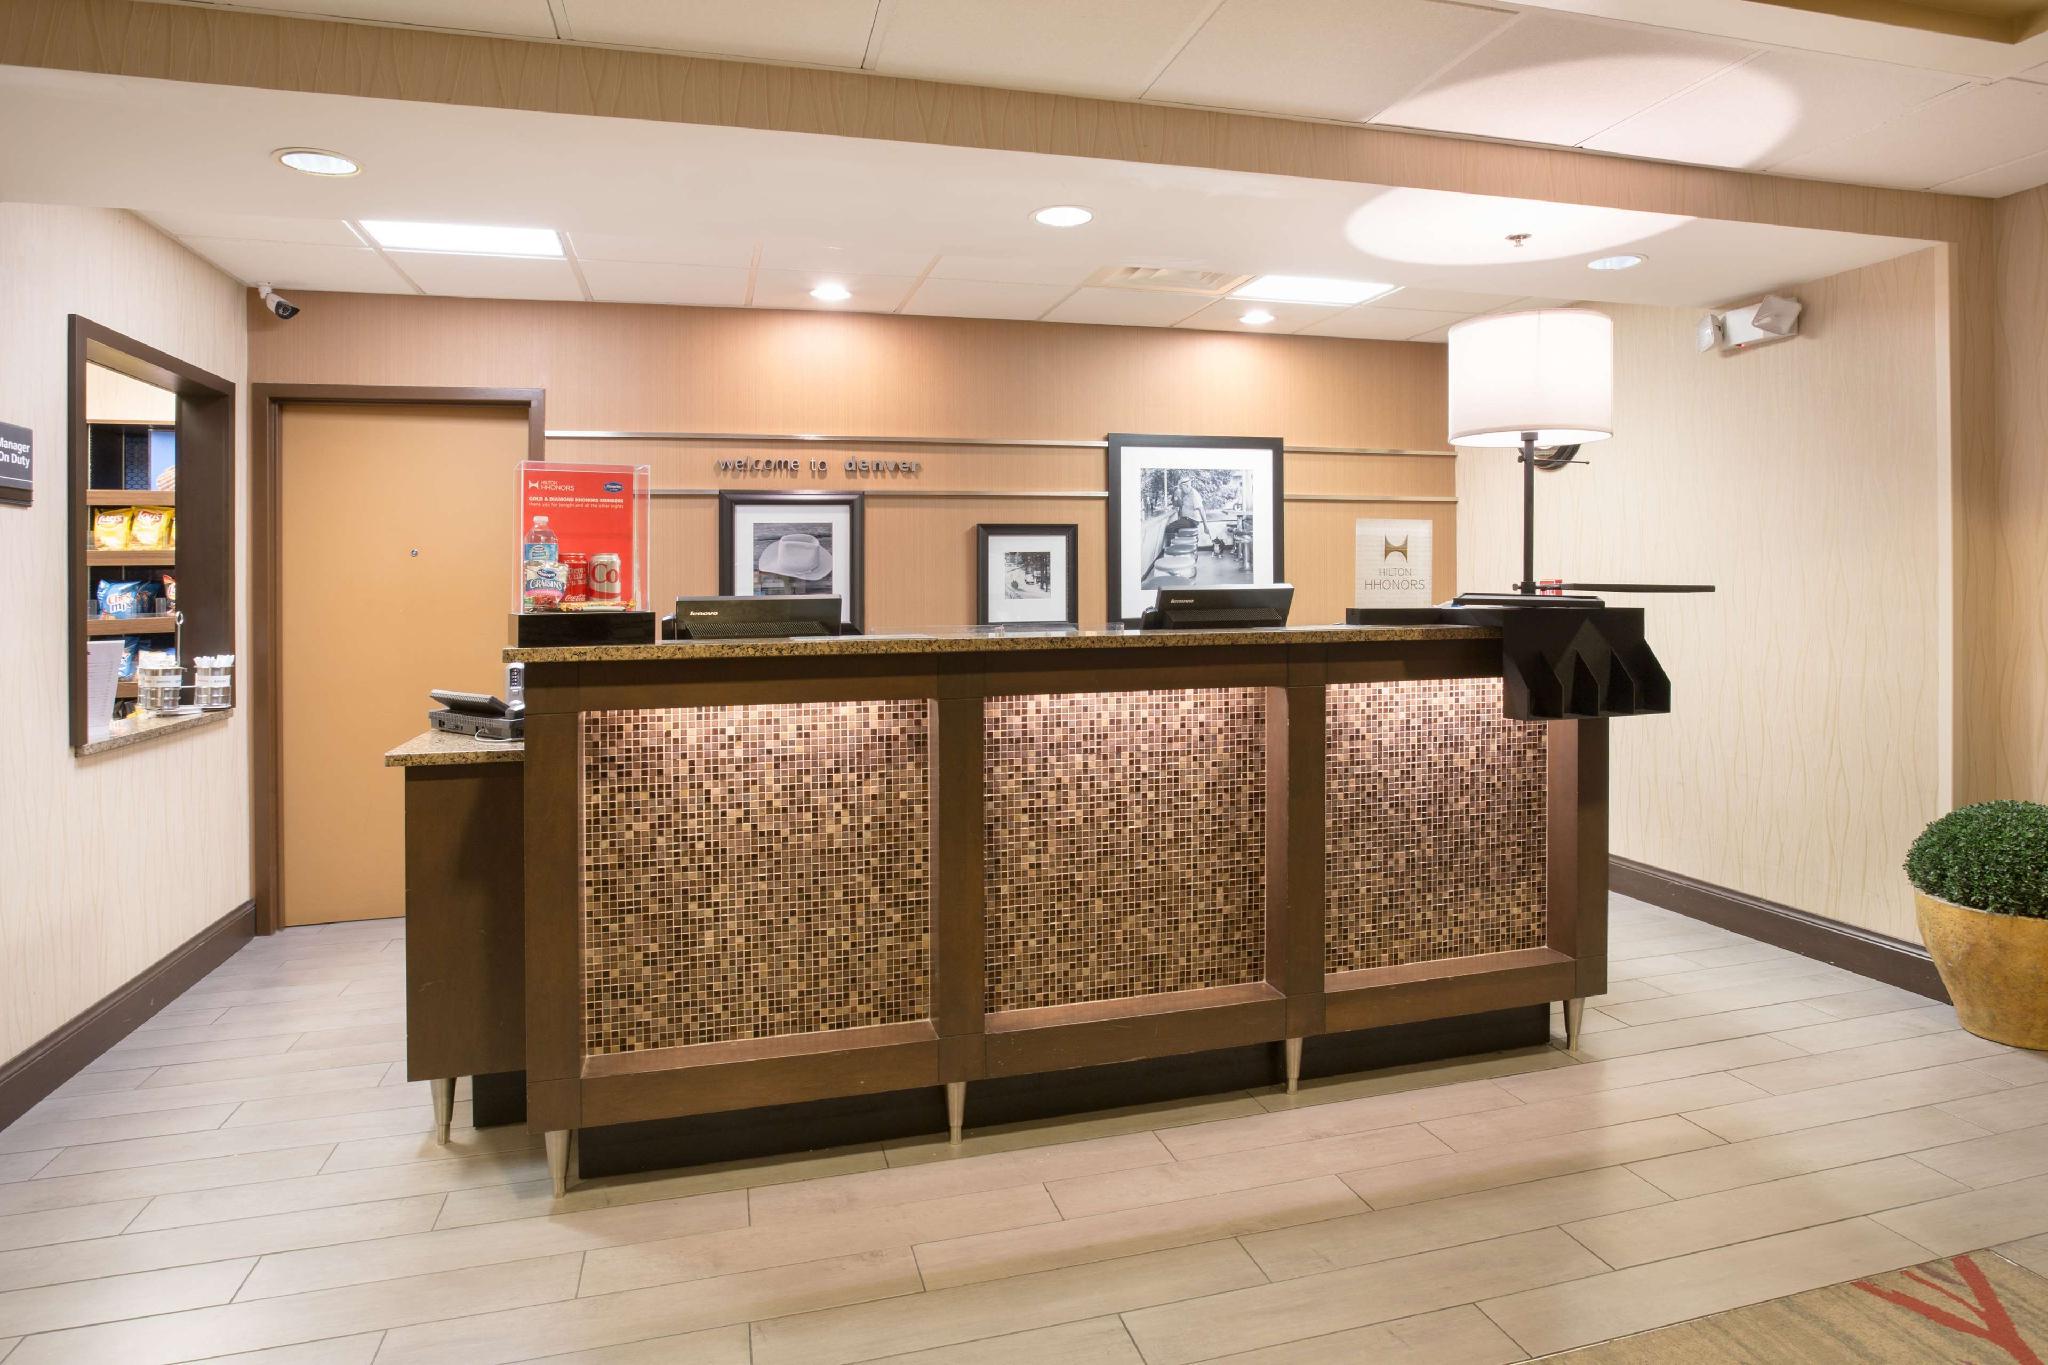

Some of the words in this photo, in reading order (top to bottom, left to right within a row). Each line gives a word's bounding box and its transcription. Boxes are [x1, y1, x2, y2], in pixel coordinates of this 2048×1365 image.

[11, 453, 30, 469] Duty
[719, 457, 800, 471] welcome
[811, 457, 828, 471] to
[844, 456, 921, 472] denver
[1379, 568, 1412, 577] HILTON
[1364, 579, 1425, 590] HHONORS
